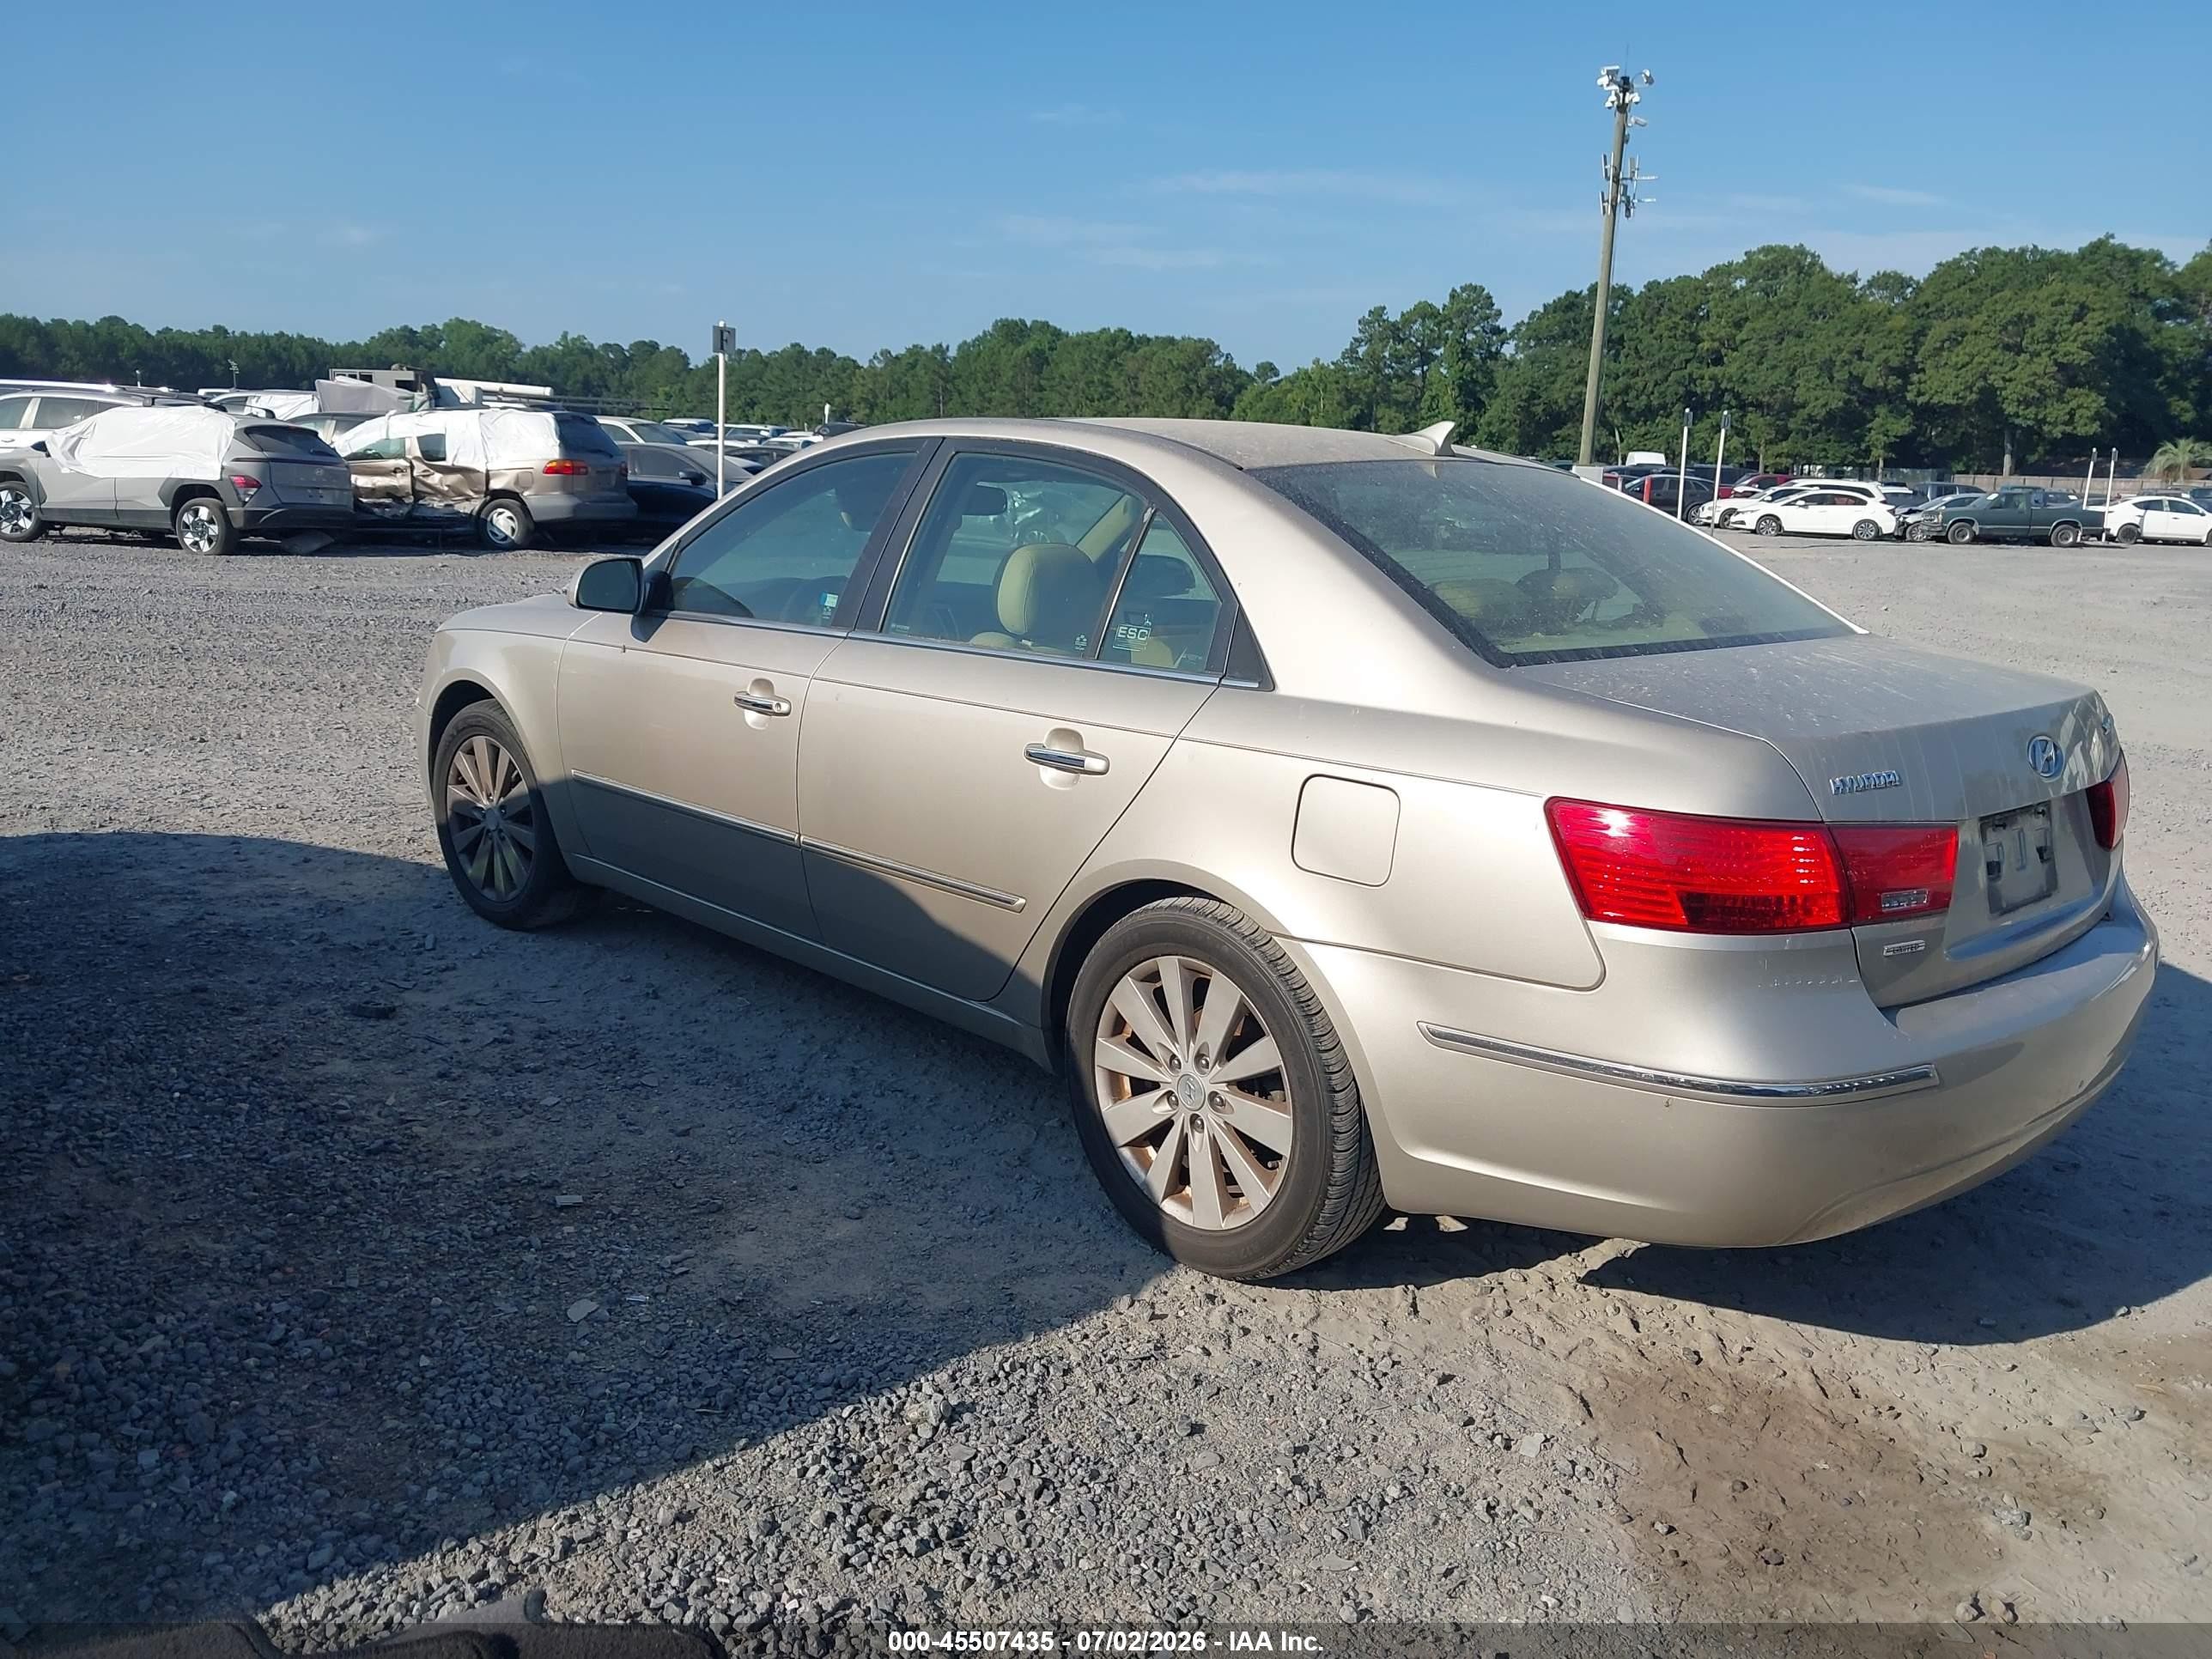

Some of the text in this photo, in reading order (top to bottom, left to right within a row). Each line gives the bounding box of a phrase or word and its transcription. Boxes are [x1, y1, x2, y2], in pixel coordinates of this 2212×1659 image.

[720, 329, 731, 350] F
[1117, 626, 1148, 640] ESC
[1829, 770, 1900, 794] HYUNDAI
